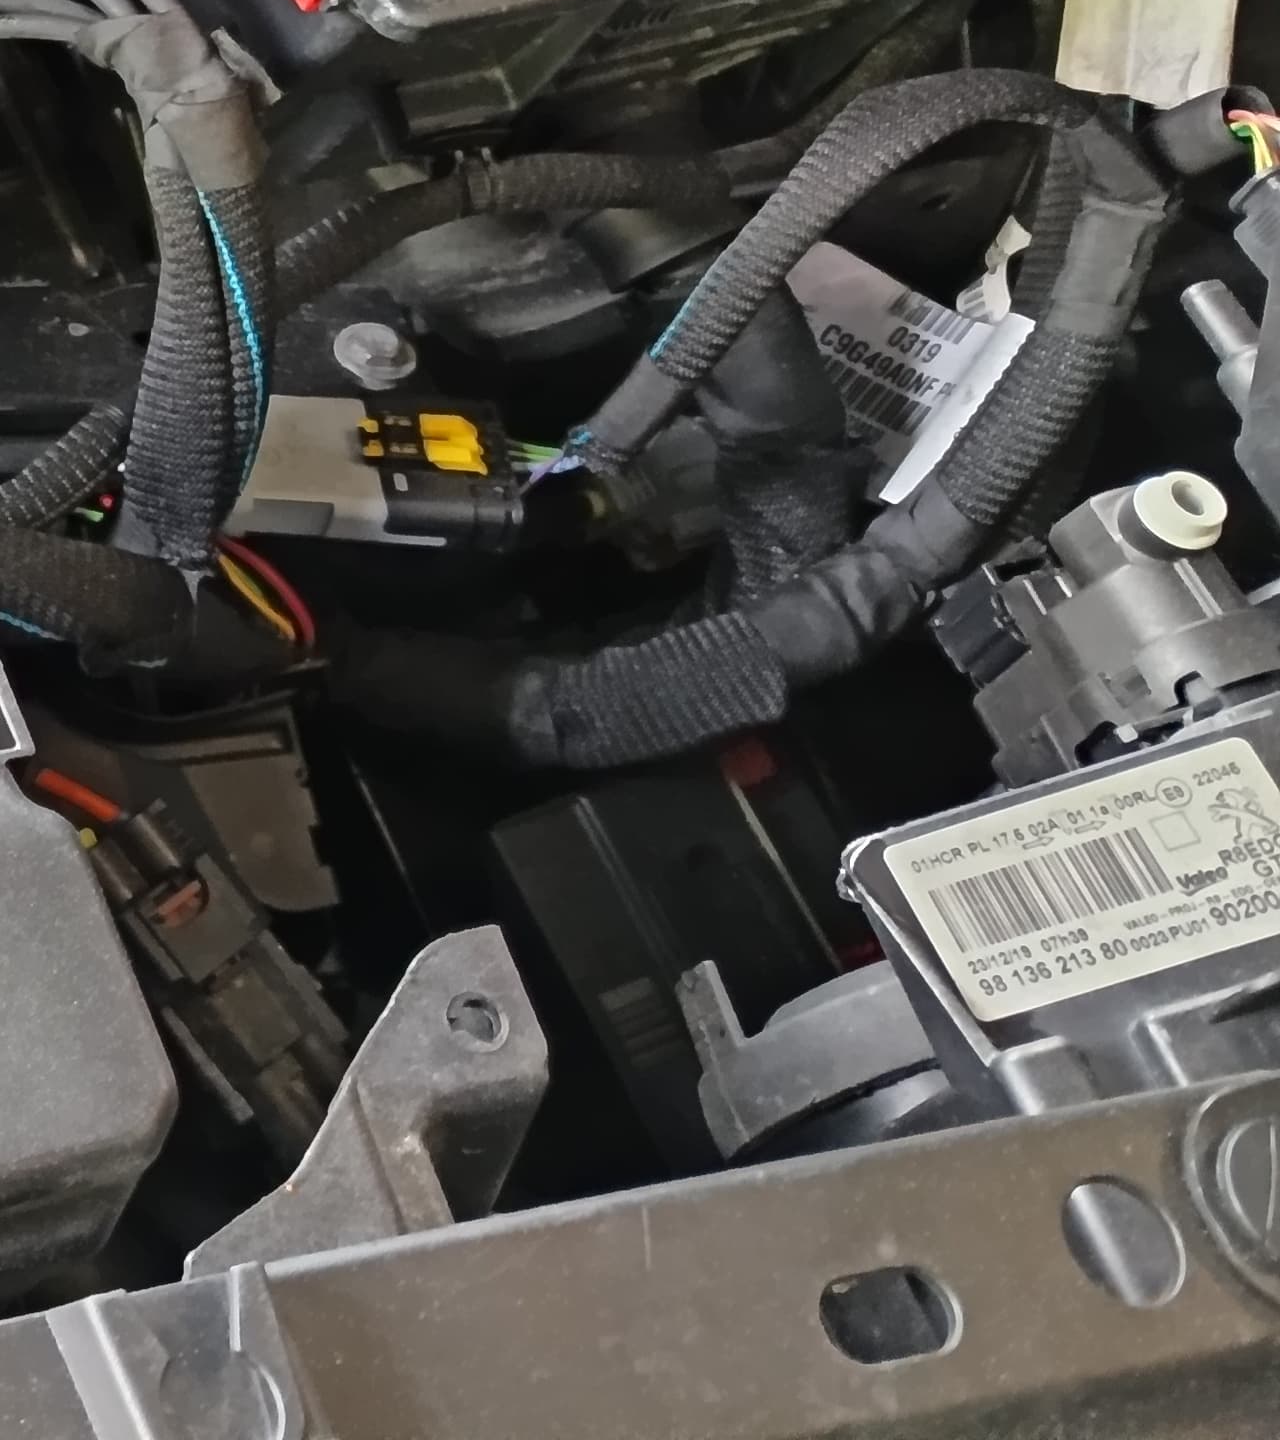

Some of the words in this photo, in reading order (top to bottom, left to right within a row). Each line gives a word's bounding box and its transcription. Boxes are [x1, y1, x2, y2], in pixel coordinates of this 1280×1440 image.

[887, 325, 943, 364] 0319
[969, 836, 992, 860] PL
[1028, 815, 1061, 838] 02A
[967, 945, 1033, 976] 23/12/19
[978, 974, 1008, 997] 98
[1011, 961, 1051, 987] 136
[1059, 947, 1098, 975] 213
[1101, 937, 1129, 961] 80
